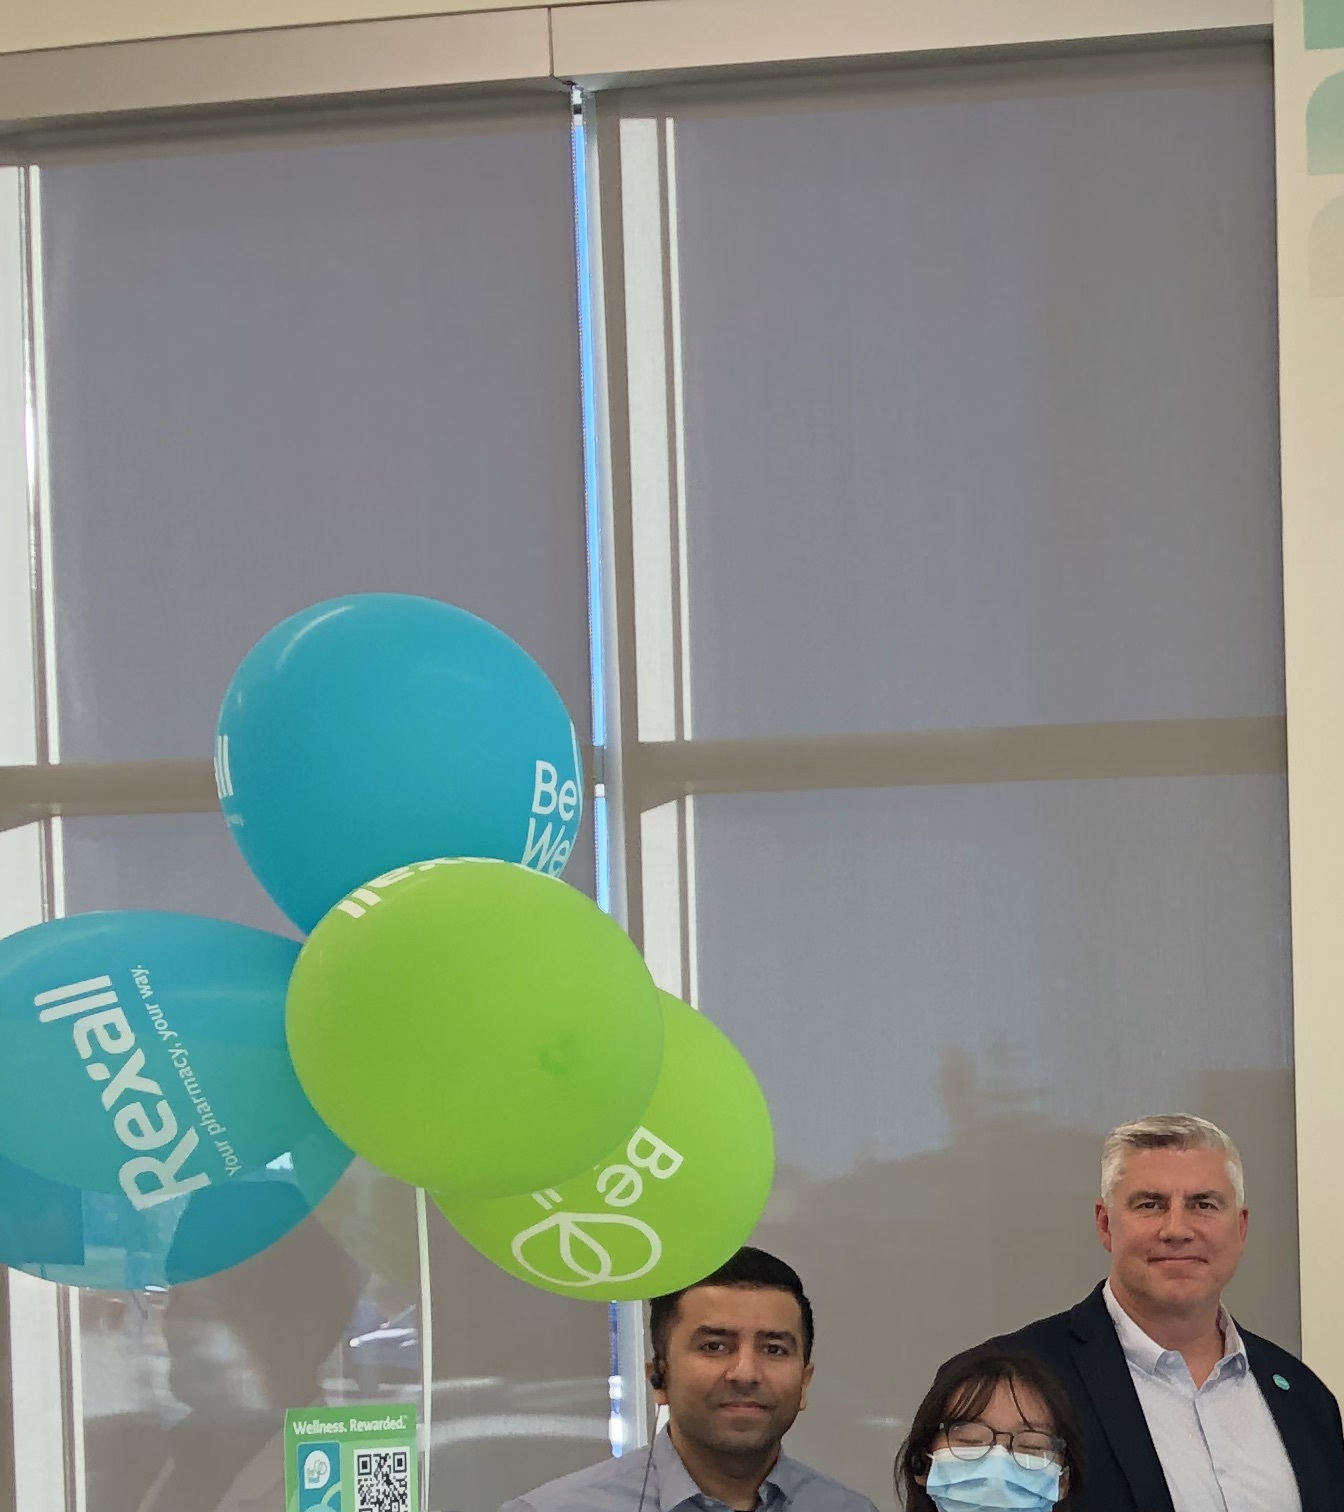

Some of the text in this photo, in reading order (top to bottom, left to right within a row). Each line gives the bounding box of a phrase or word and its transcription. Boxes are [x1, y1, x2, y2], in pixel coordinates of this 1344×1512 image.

[531, 760, 577, 821] Be
[34, 974, 212, 1212] Rexall
[130, 964, 243, 1178] Your pharmacy, your way.
[597, 1125, 685, 1210] Be
[293, 1420, 347, 1435] Wellness.
